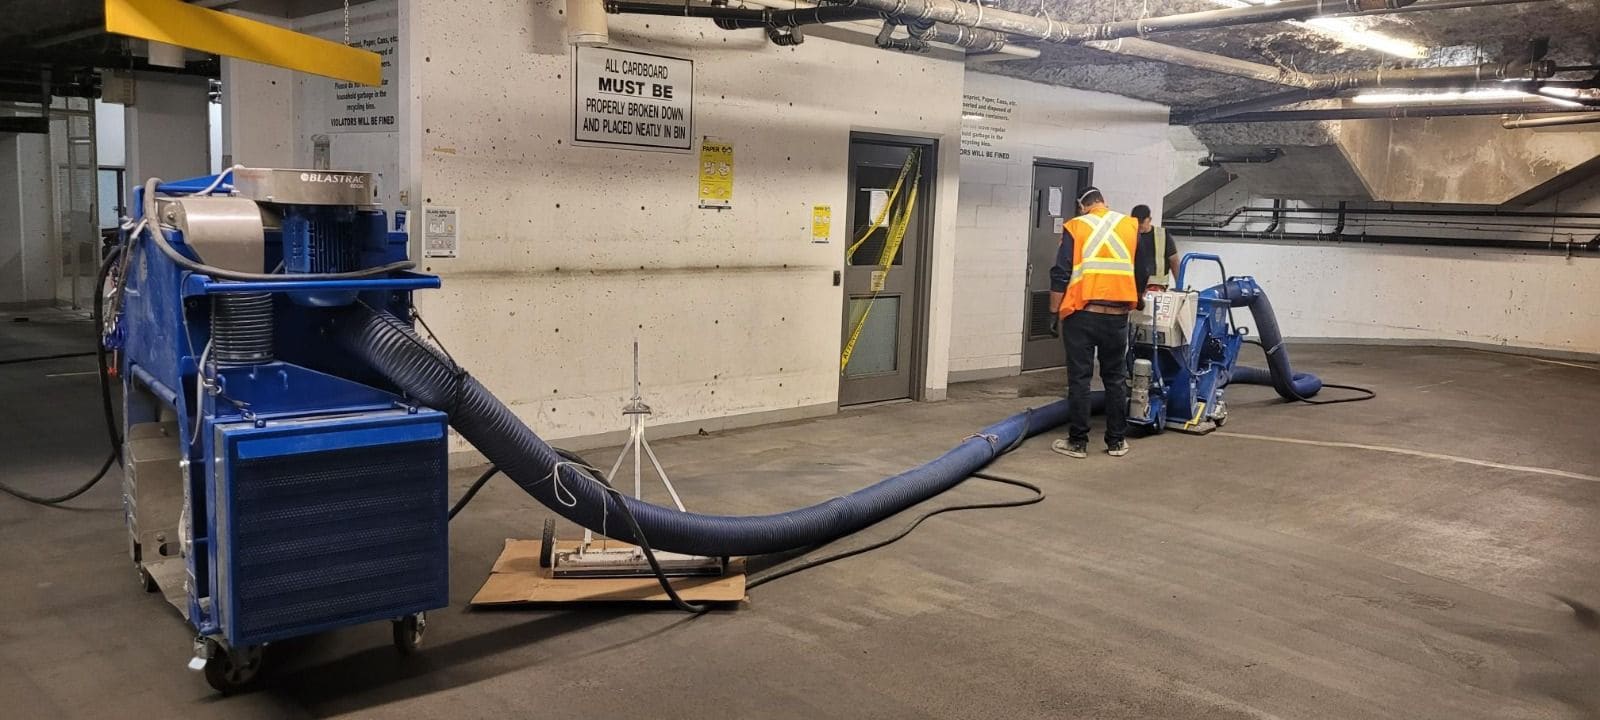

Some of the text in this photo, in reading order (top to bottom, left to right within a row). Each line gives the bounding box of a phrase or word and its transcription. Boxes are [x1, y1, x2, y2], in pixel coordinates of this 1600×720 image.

[605, 58, 668, 79] ALL CARDBOARD
[598, 77, 673, 99] MUST BE
[586, 98, 684, 121] PROPERLY BROKEN DOWN
[331, 115, 395, 127] VIOLATORS WILL BE FINED
[583, 117, 685, 139] AND PLACED NEATLY IN BIN
[972, 149, 985, 157] WILL
[994, 151, 1010, 160] FINED
[309, 173, 364, 183] BLASTRAC
